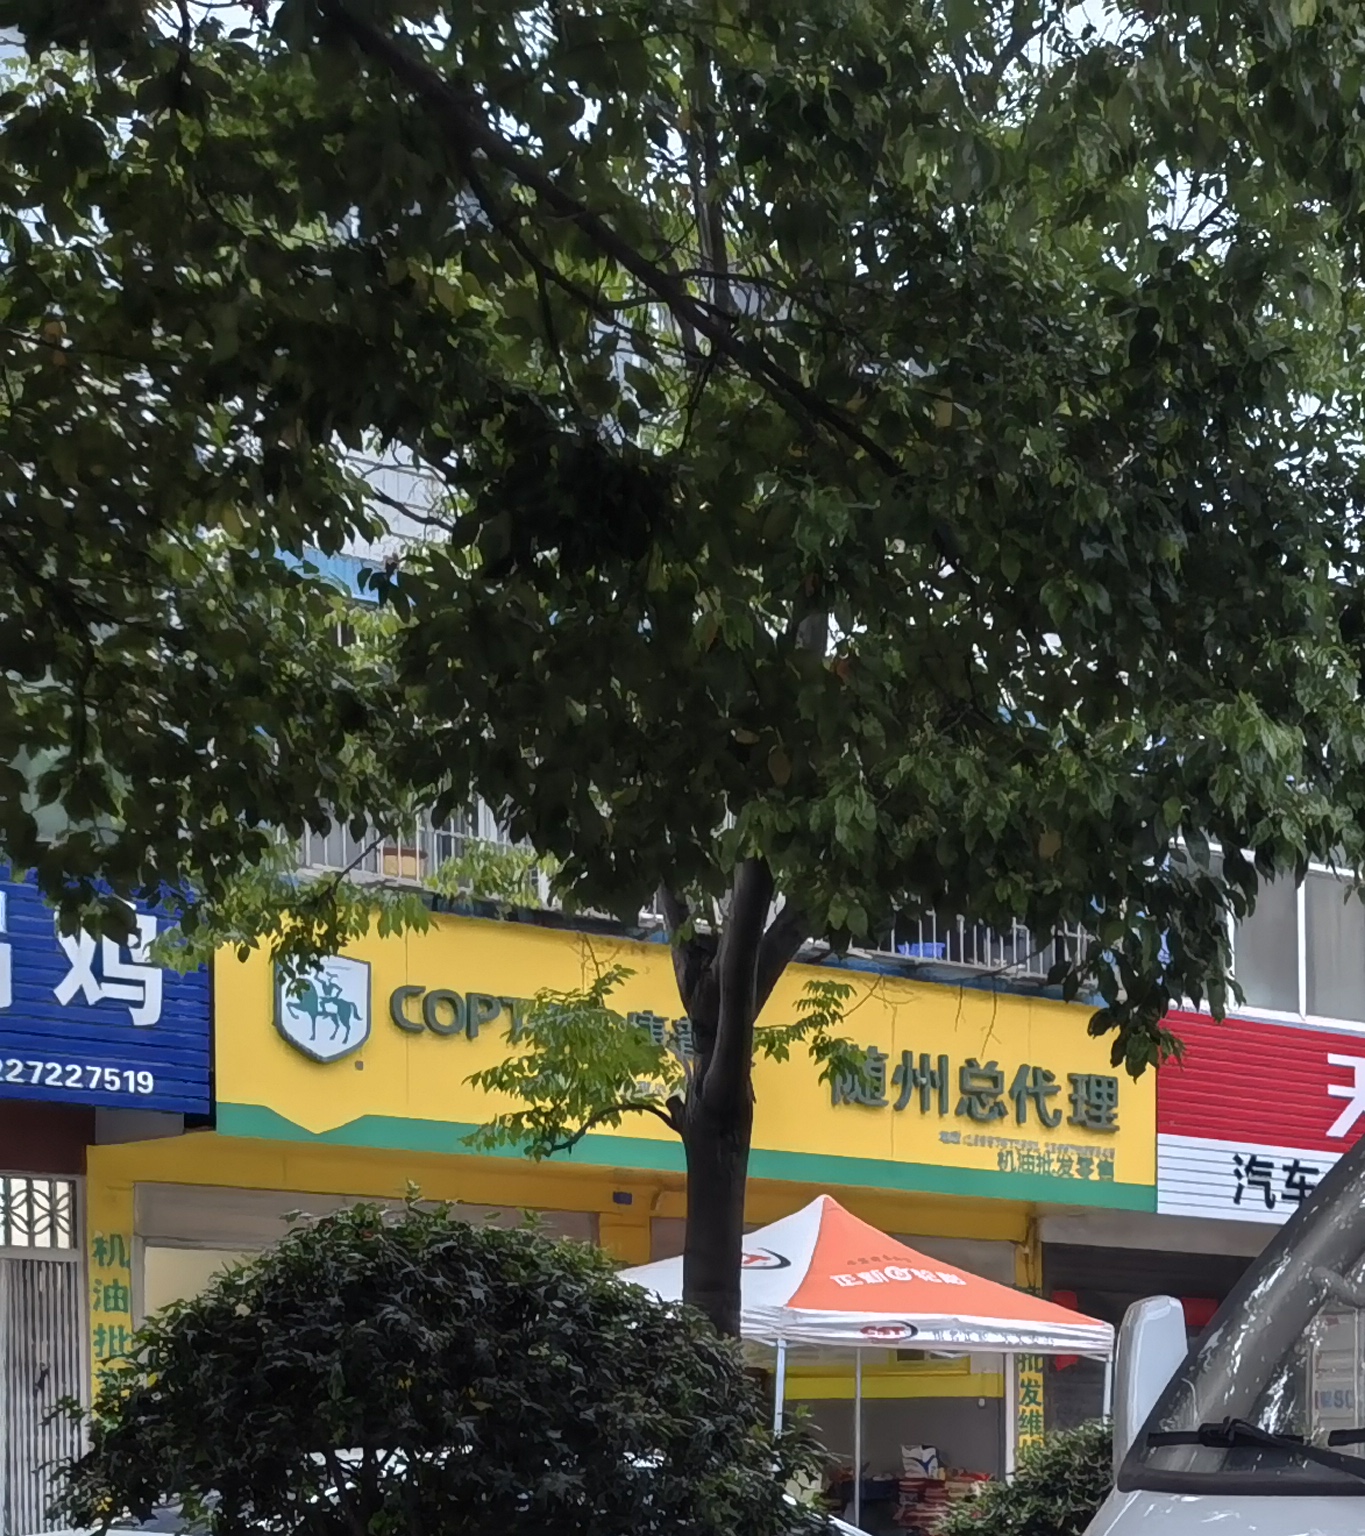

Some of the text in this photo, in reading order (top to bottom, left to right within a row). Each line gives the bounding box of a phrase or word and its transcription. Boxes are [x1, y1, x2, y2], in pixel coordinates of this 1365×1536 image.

[0, 892, 163, 1026] 鸡
[389, 984, 536, 1042] COPT
[0, 1058, 154, 1094] 27227519
[831, 1046, 1120, 1131] 随州总代理
[1233, 1152, 1320, 1210] 汽车
[92, 1233, 136, 1386] 机油批
